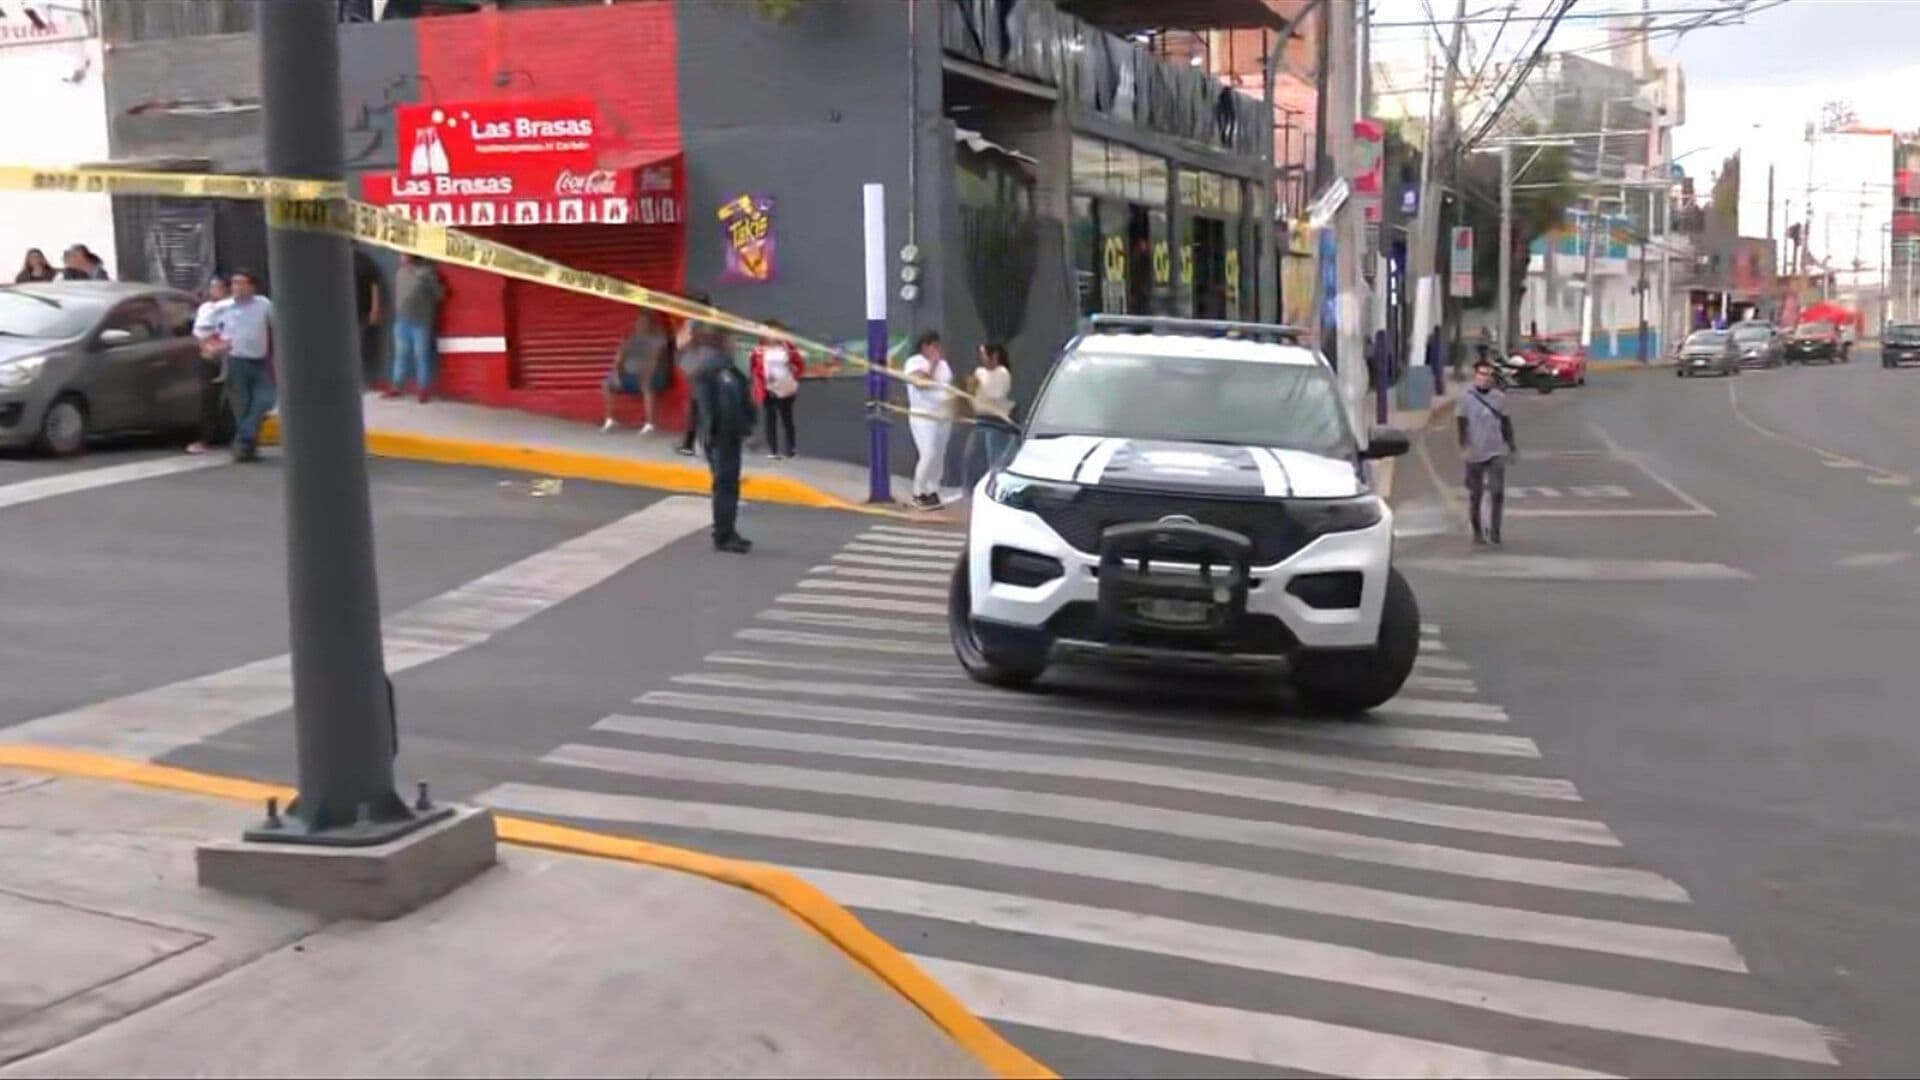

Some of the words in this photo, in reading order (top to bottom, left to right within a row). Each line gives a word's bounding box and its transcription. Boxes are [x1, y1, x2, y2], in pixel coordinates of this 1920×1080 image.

[471, 119, 511, 139] Las
[515, 117, 592, 138] Brasas
[392, 177, 431, 195] Las
[436, 176, 513, 195] Brasas
